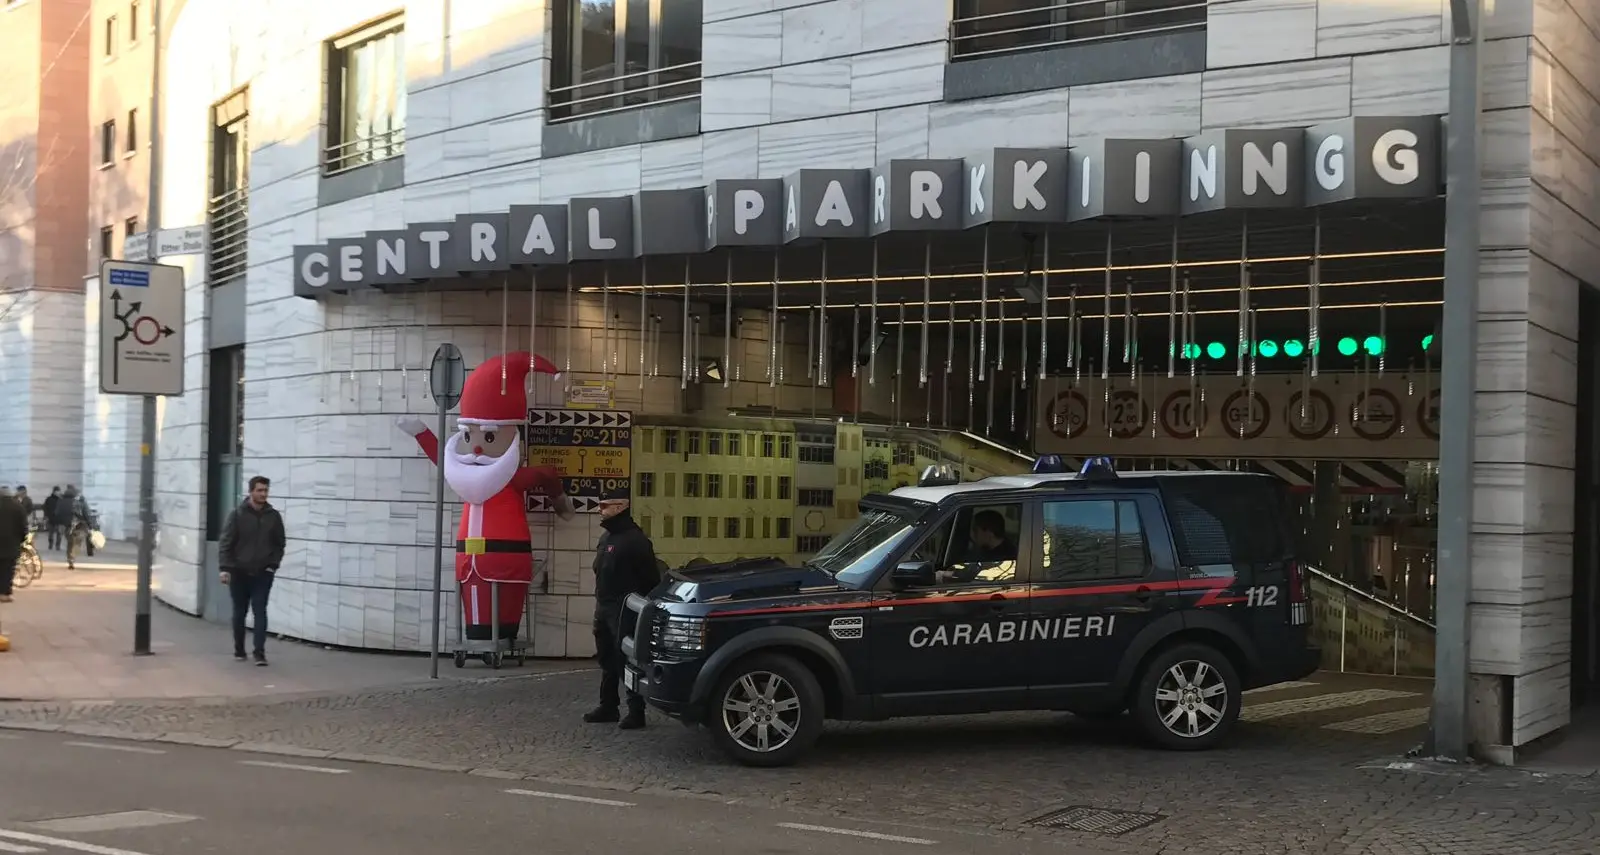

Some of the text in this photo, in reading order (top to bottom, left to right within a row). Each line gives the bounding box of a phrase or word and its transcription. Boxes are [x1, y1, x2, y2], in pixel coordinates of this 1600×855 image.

[302, 207, 617, 288] CENTRAL
[595, 449, 623, 457] ORARIO
[594, 467, 623, 475] ENTRATA
[1244, 585, 1279, 608] 112
[909, 614, 1115, 649] CARABINIERI
